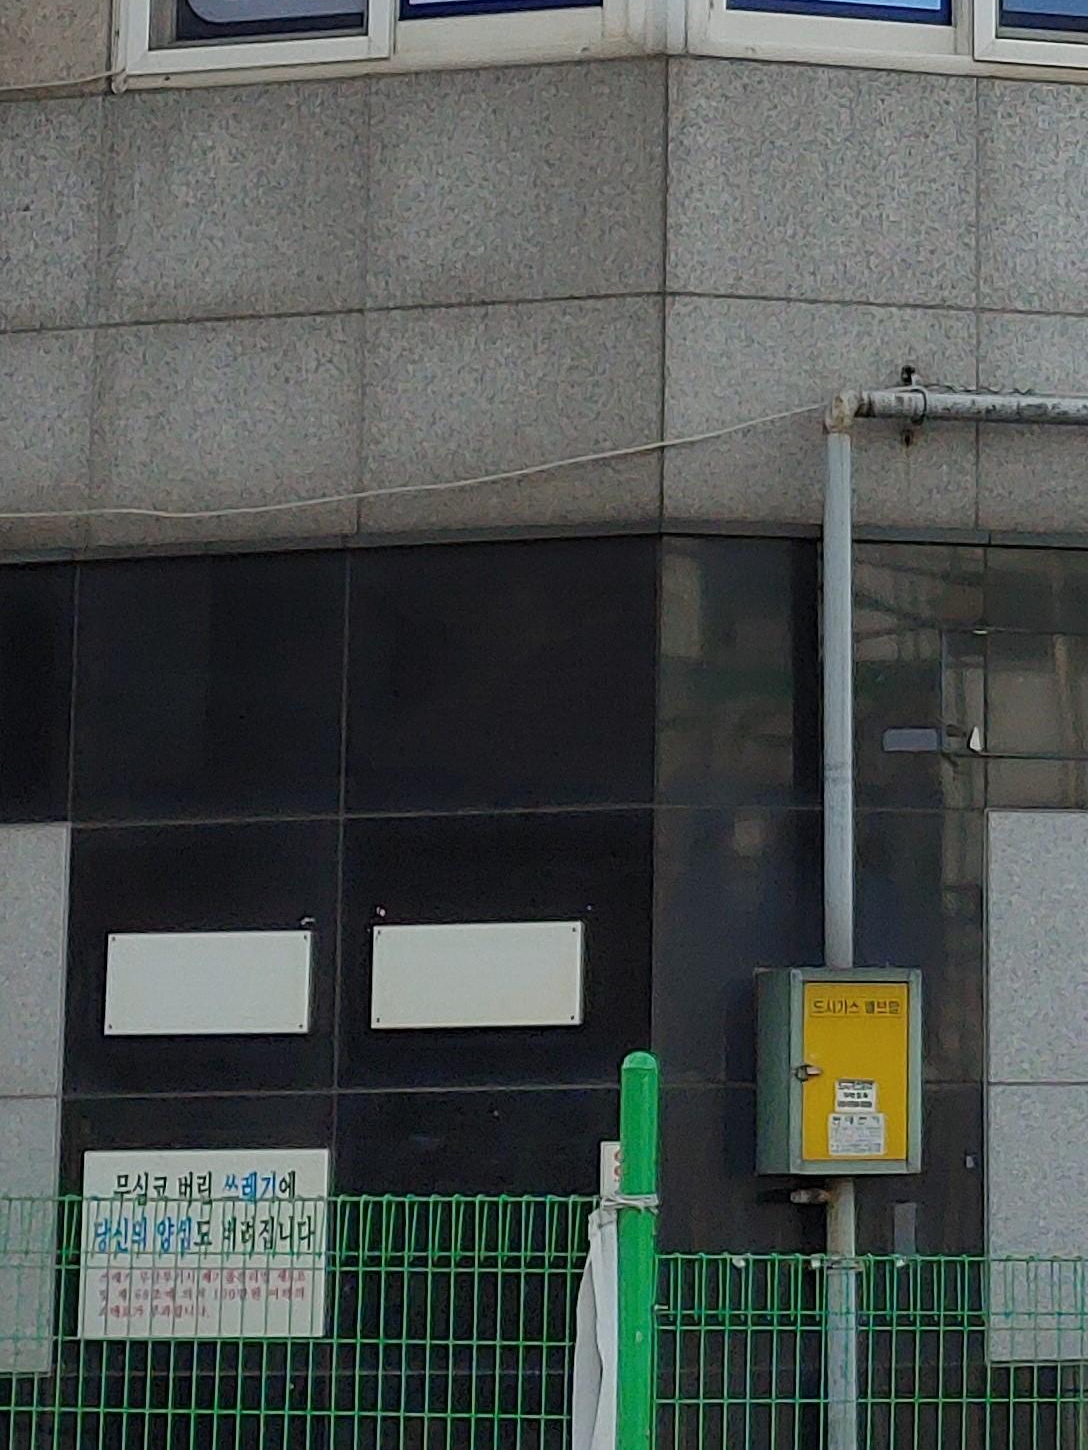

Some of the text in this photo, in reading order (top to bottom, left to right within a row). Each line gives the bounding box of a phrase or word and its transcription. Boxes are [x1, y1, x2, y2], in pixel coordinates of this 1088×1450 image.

[813, 999, 860, 1015] 도시가스
[114, 1171, 167, 1206] 무심코
[223, 1171, 296, 1204] 쓰레기에
[94, 1214, 315, 1253] 당신의 양심도 버려집니다
